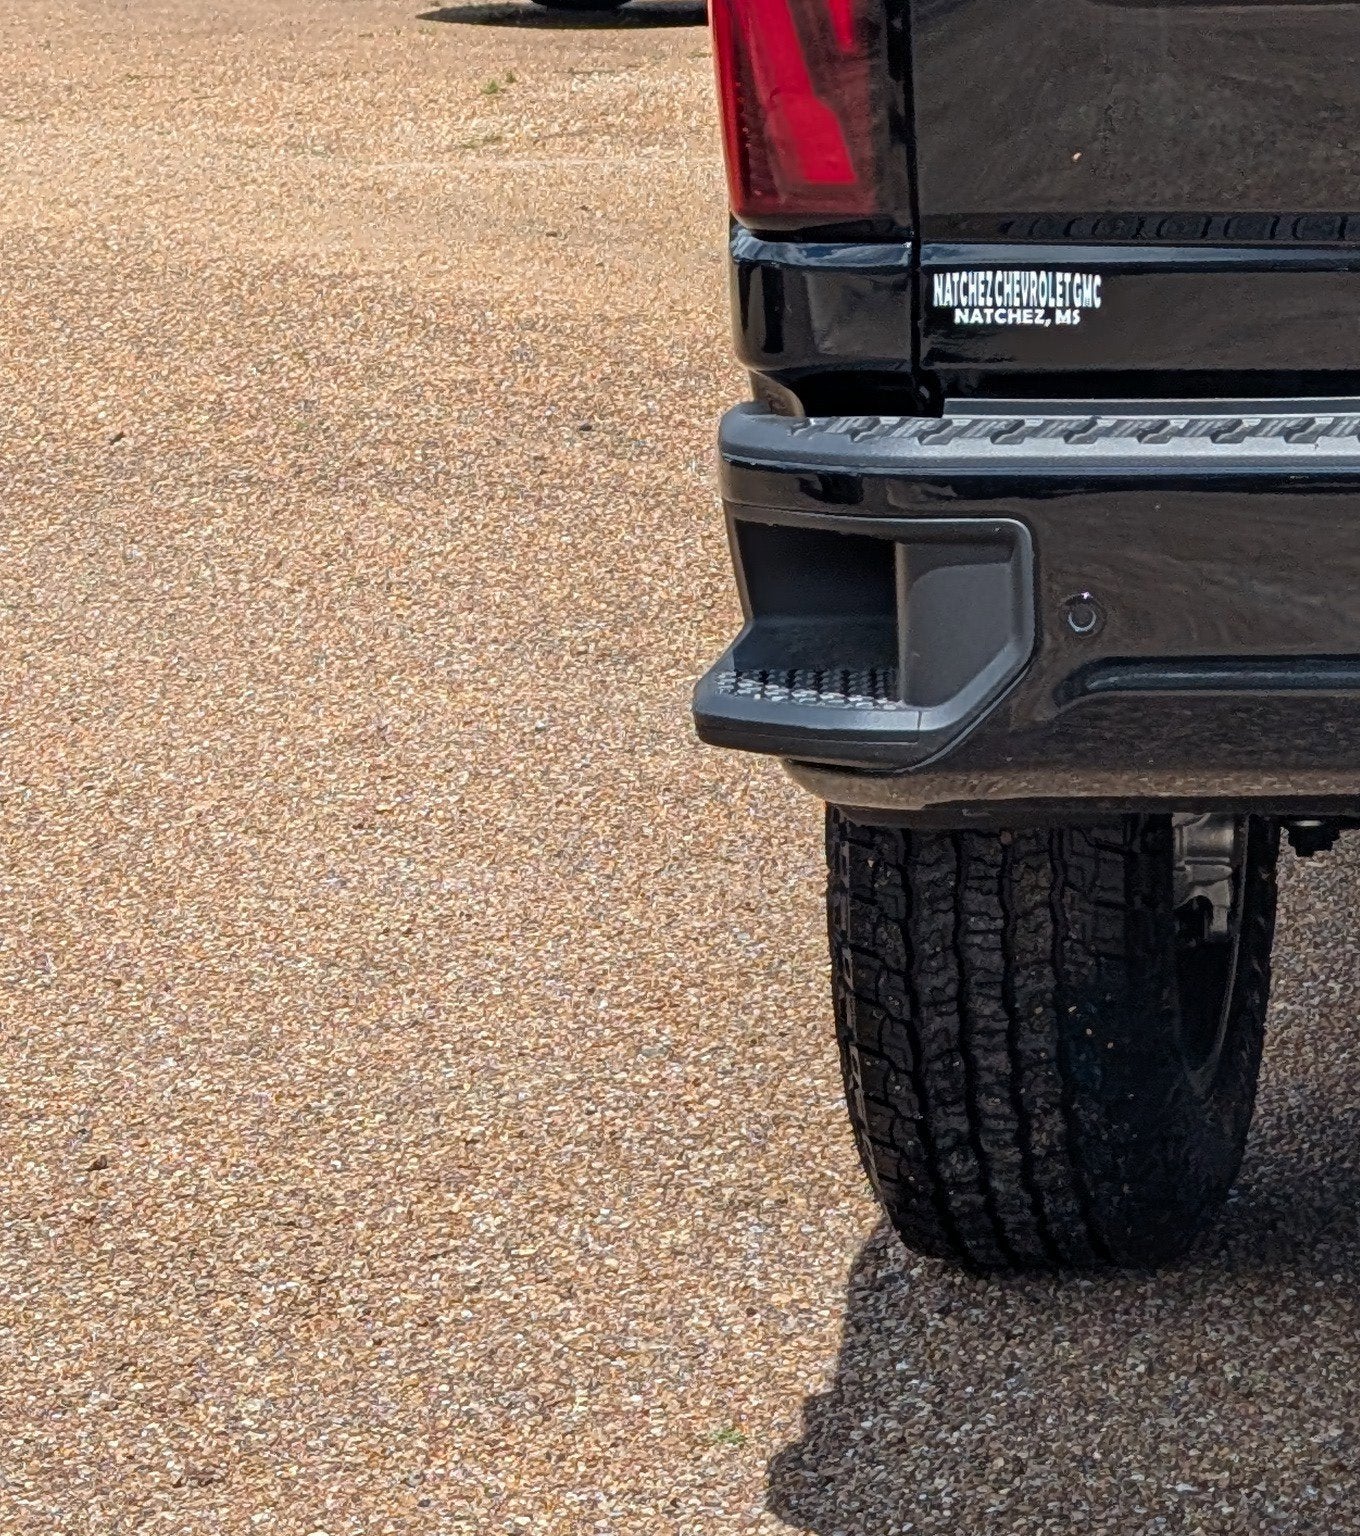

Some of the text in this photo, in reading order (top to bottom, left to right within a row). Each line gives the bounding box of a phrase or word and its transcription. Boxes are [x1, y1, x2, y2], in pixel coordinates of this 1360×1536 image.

[933, 271, 1101, 308] NATCHEZ CHEVROLET GMC
[954, 308, 1081, 326] NATCHEZ, MS
